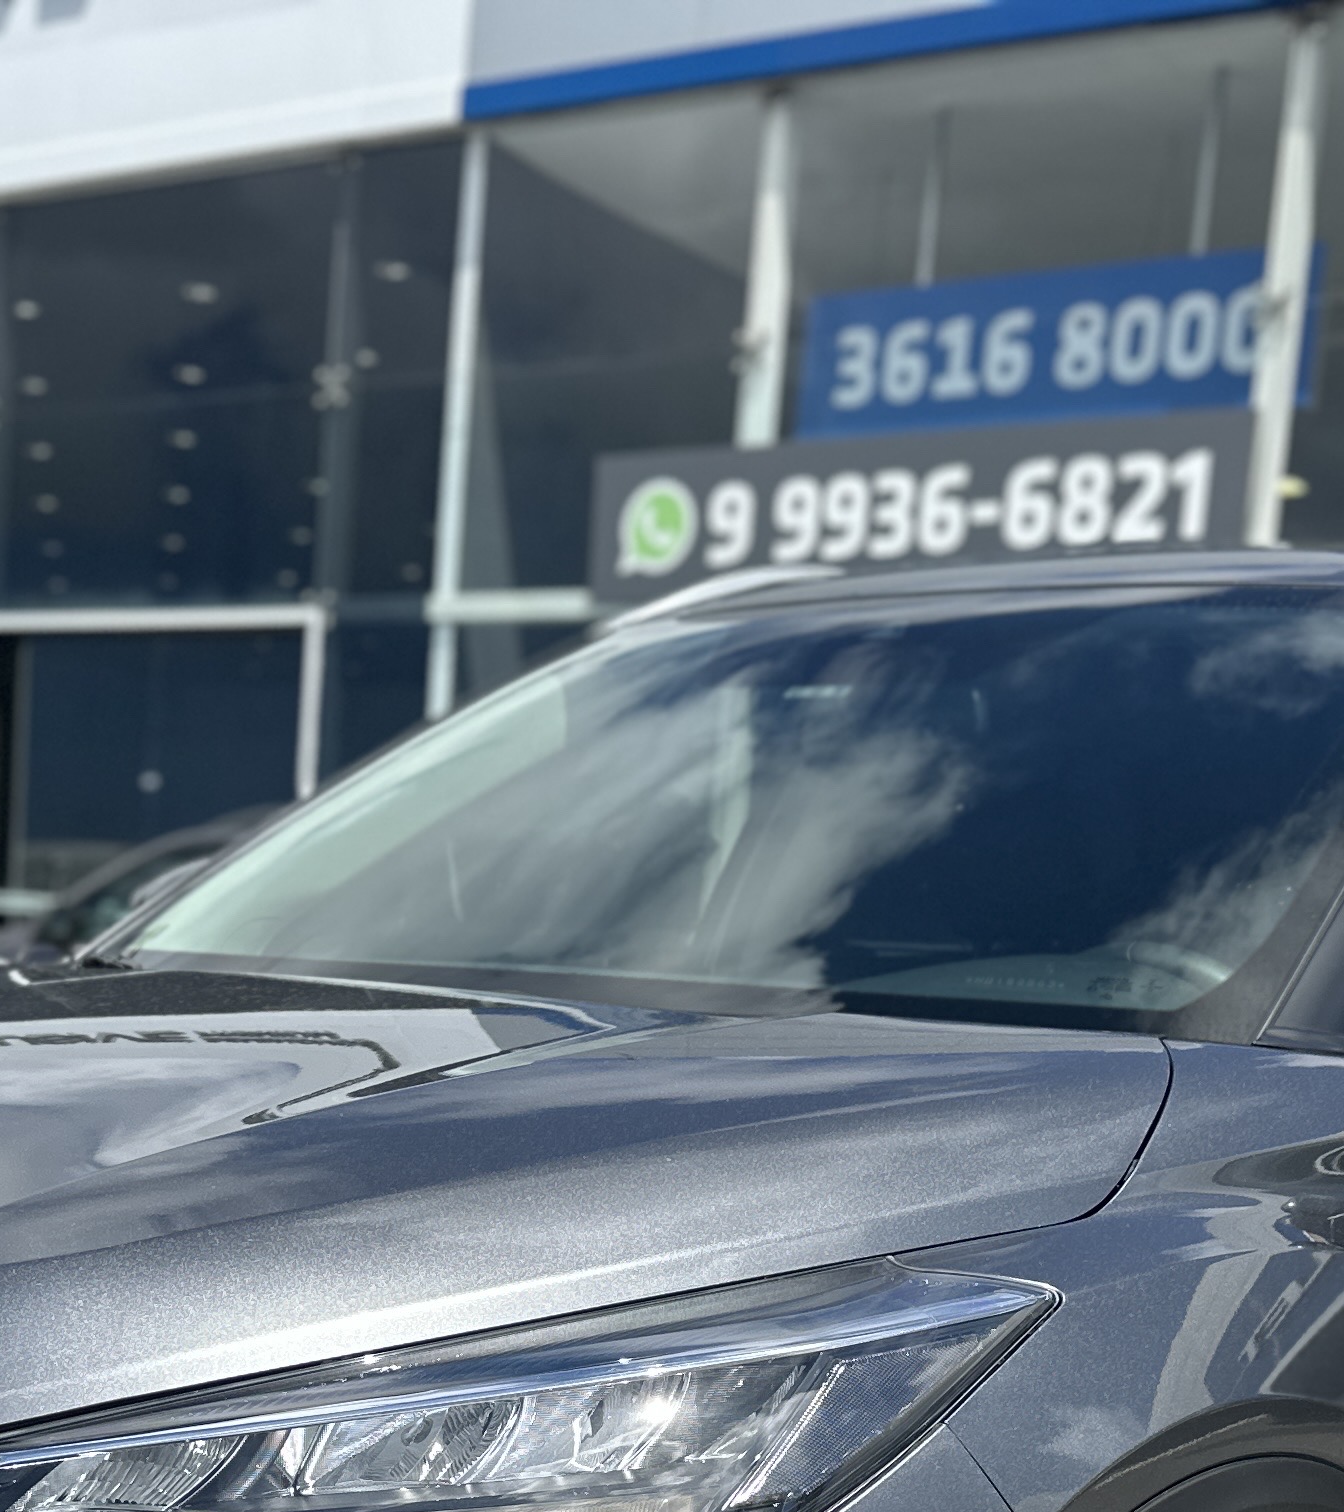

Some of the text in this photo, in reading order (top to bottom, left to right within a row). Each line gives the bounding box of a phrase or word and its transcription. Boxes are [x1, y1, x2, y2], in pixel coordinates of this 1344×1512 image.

[828, 306, 1037, 412] 3616
[703, 446, 1214, 567] 9 9936-6821
